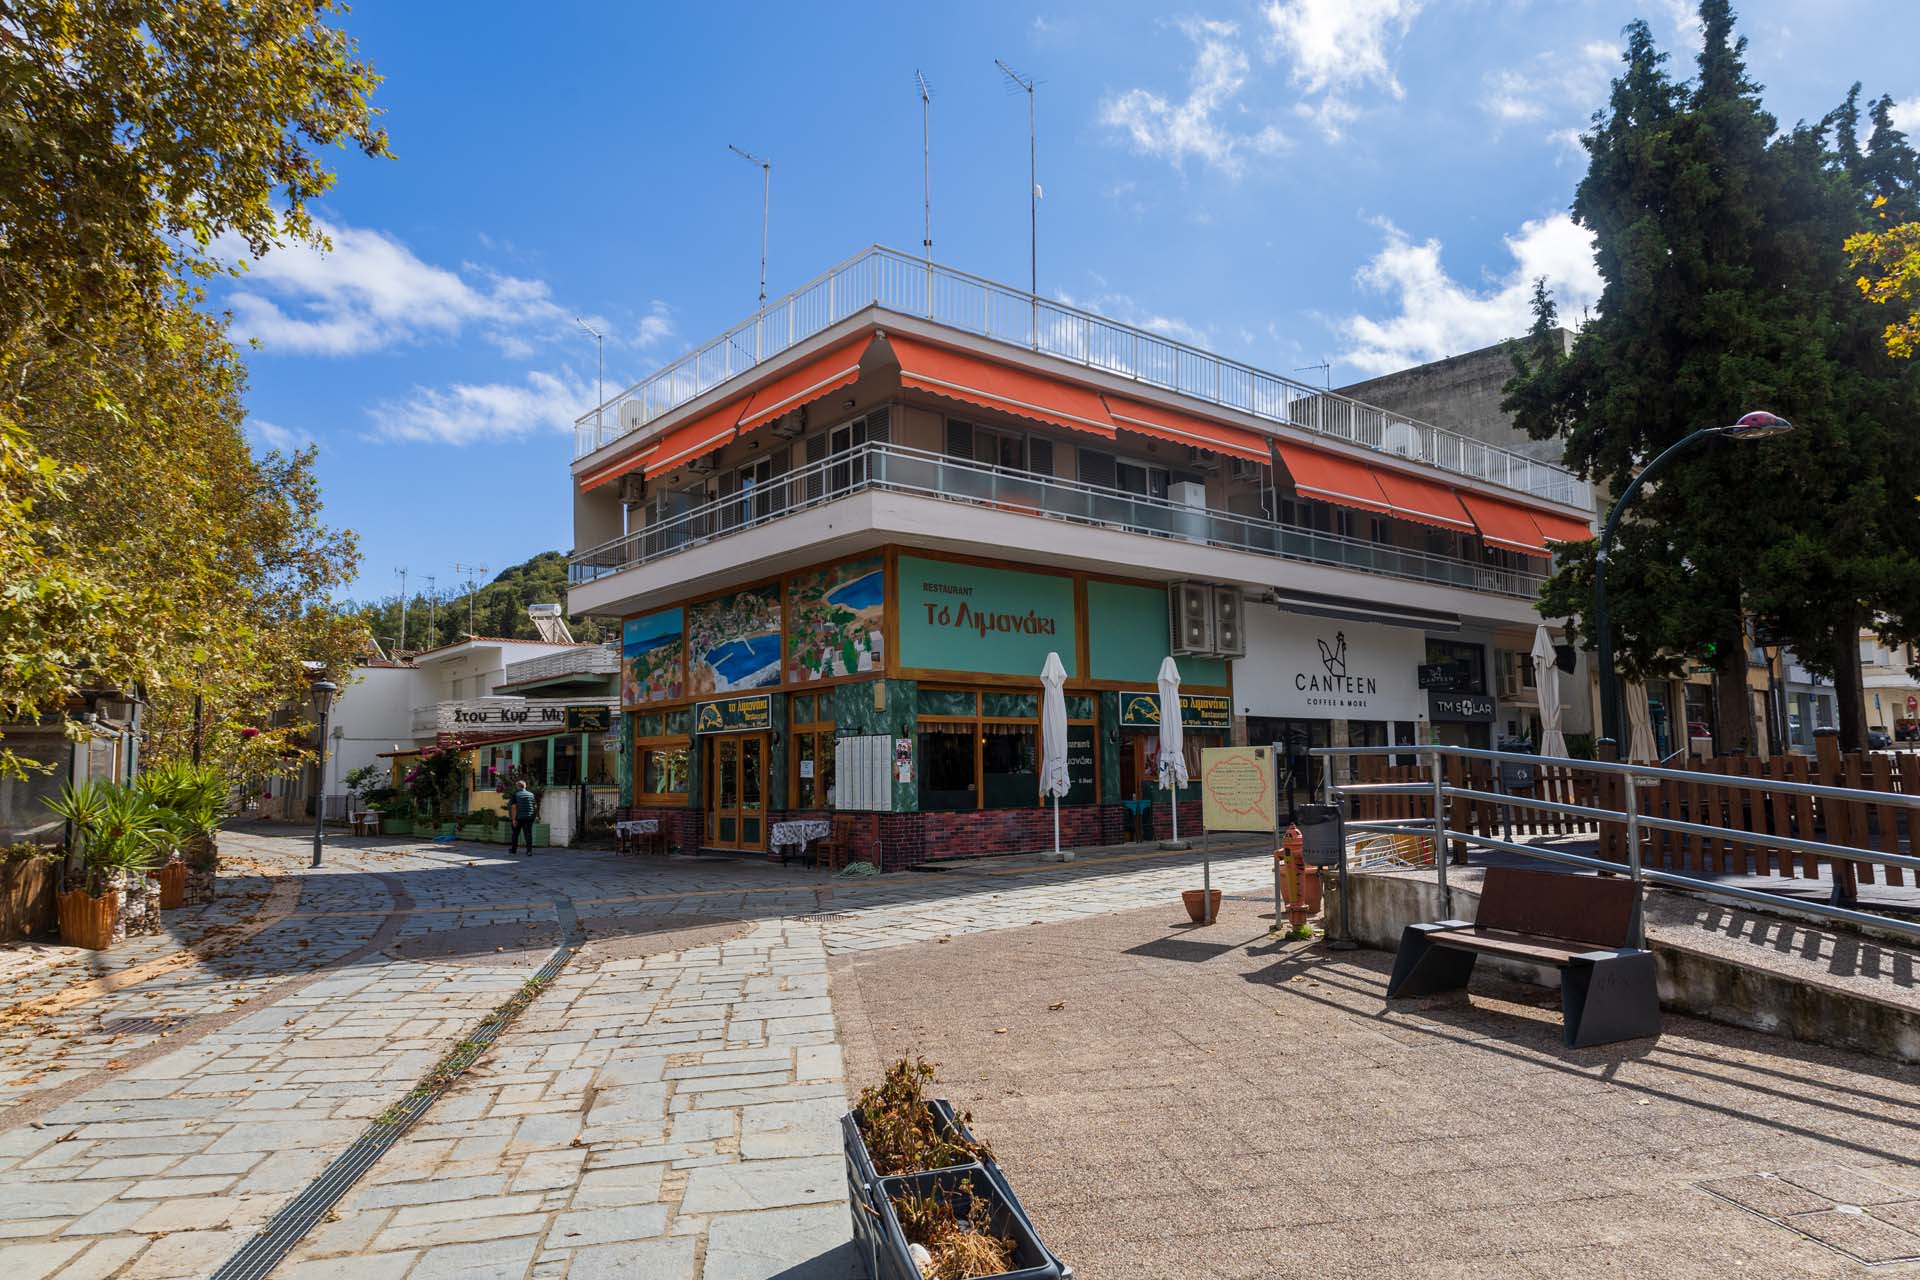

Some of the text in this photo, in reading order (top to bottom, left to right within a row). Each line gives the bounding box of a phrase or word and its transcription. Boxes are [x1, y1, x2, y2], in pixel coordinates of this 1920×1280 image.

[923, 582, 973, 596] RESTAURANT
[955, 601, 1056, 638] Λιμανάκι
[1295, 673, 1376, 694] CANTEEN
[1306, 698, 1336, 706] COFFEE
[1437, 700, 1492, 716] TM SOLAR
[455, 708, 487, 723] Στου
